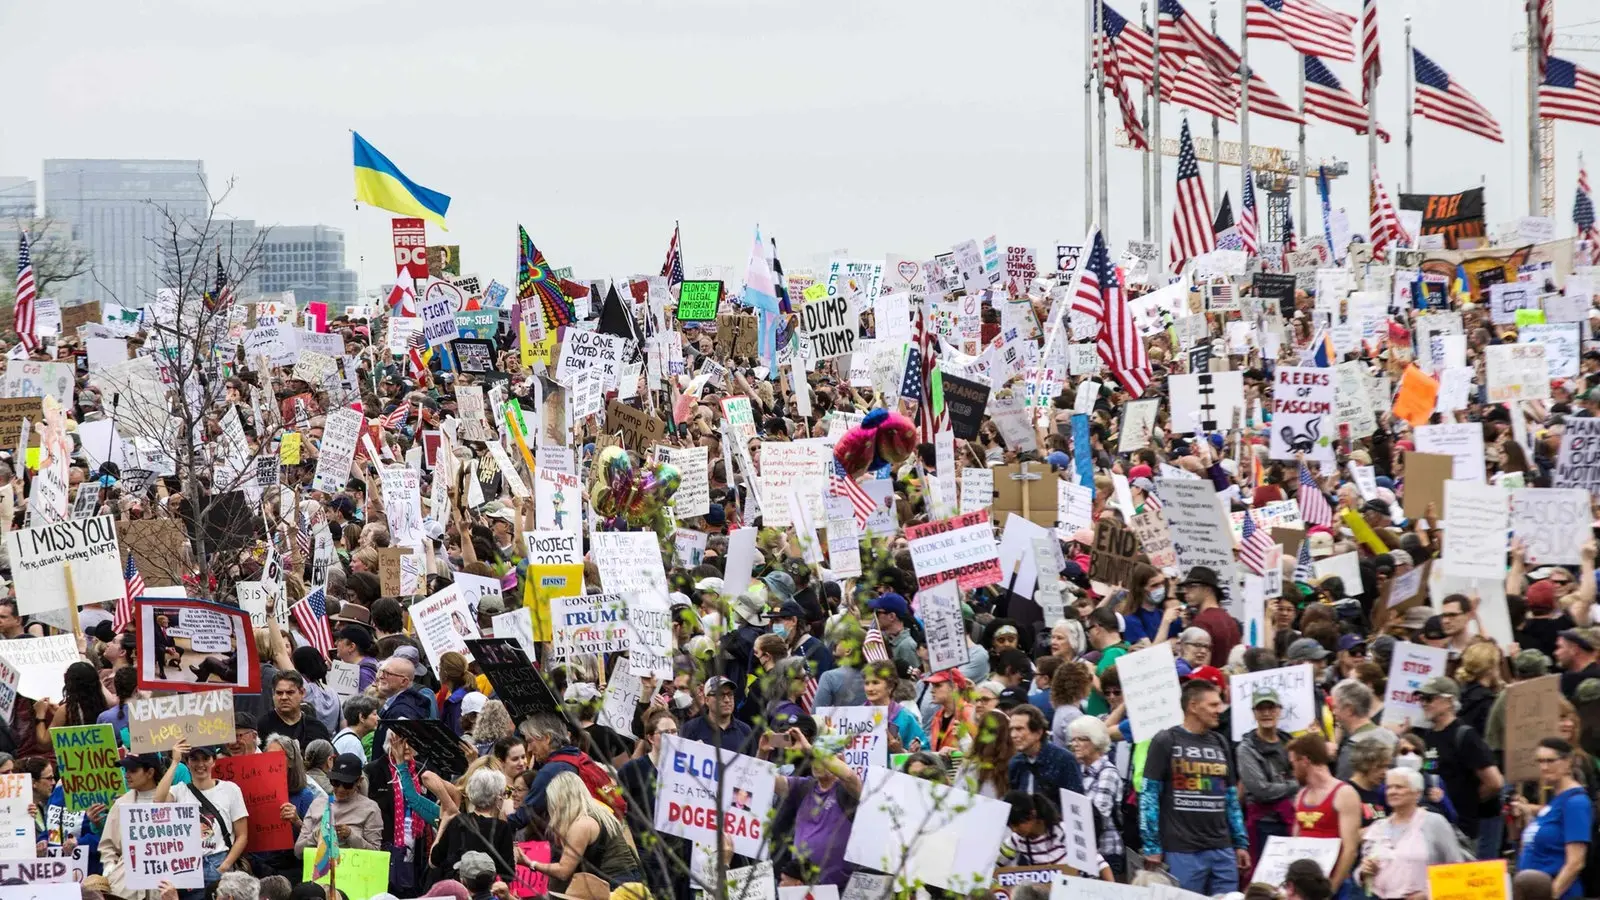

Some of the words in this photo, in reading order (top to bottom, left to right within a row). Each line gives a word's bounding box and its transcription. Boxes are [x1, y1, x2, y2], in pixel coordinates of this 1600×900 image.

[394, 235, 425, 246] FREE
[396, 248, 426, 265] DC
[1008, 254, 1024, 262] LIST
[1006, 262, 1036, 270] THINGS
[453, 277, 478, 288] HANDS
[684, 283, 698, 292] ELON
[699, 284, 706, 292] IS
[707, 283, 718, 292] THE
[688, 292, 711, 301] ILLEGAL
[422, 300, 450, 321] FIGHT
[681, 301, 714, 310] IMMIGRANT
[681, 310, 690, 318] TO
[692, 310, 715, 319] DEPORT
[806, 297, 848, 332] DUMP
[254, 328, 279, 340] HANDS
[572, 333, 588, 344] NO
[592, 336, 614, 348] ONE
[810, 328, 854, 358] TRUMP
[571, 344, 597, 358] VOTED
[600, 349, 616, 360] FOR
[566, 358, 586, 370] ELON
[1280, 372, 1330, 386] REEKS
[1297, 388, 1312, 398] OF
[1274, 400, 1330, 414] FASCISM
[614, 406, 642, 429] trump
[645, 416, 656, 434] IS
[540, 469, 555, 482] ALL
[557, 472, 578, 488] POWER
[915, 523, 954, 538] HANDS
[963, 514, 982, 527] OFF
[16, 532, 24, 558] I
[31, 522, 76, 556] MISS
[73, 516, 114, 548] YOU
[528, 536, 574, 552] PROJECT
[1097, 524, 1136, 558] END
[912, 539, 956, 556] MEDICARE
[960, 536, 968, 544] &
[40, 555, 64, 568] drunk
[90, 544, 117, 558] NAFTA
[916, 556, 948, 570] SOCIAL
[954, 544, 994, 560] SECURITY
[919, 574, 938, 587] OUR
[942, 558, 1000, 582] DEMOCRACY
[564, 594, 621, 606] CONGRESS
[634, 610, 672, 630] PROTECT
[580, 642, 613, 653] YOUR
[636, 632, 665, 648] SOCIAL
[631, 652, 672, 674] SECURITY
[1400, 662, 1433, 676] STOP
[490, 666, 538, 682] FASCIST
[128, 689, 233, 722] VENEZUELANS
[150, 724, 184, 746] here
[185, 722, 194, 734] to
[839, 718, 874, 734] HANDS
[56, 729, 104, 748] MAKE
[62, 773, 122, 794] WRONG
[673, 783, 684, 793] IS
[686, 784, 694, 796] A
[72, 792, 108, 810] AGAIN
[151, 808, 170, 821] NOT
[175, 807, 194, 820] THE
[129, 823, 192, 840] ECONOMY
[18, 862, 66, 881] NEED
